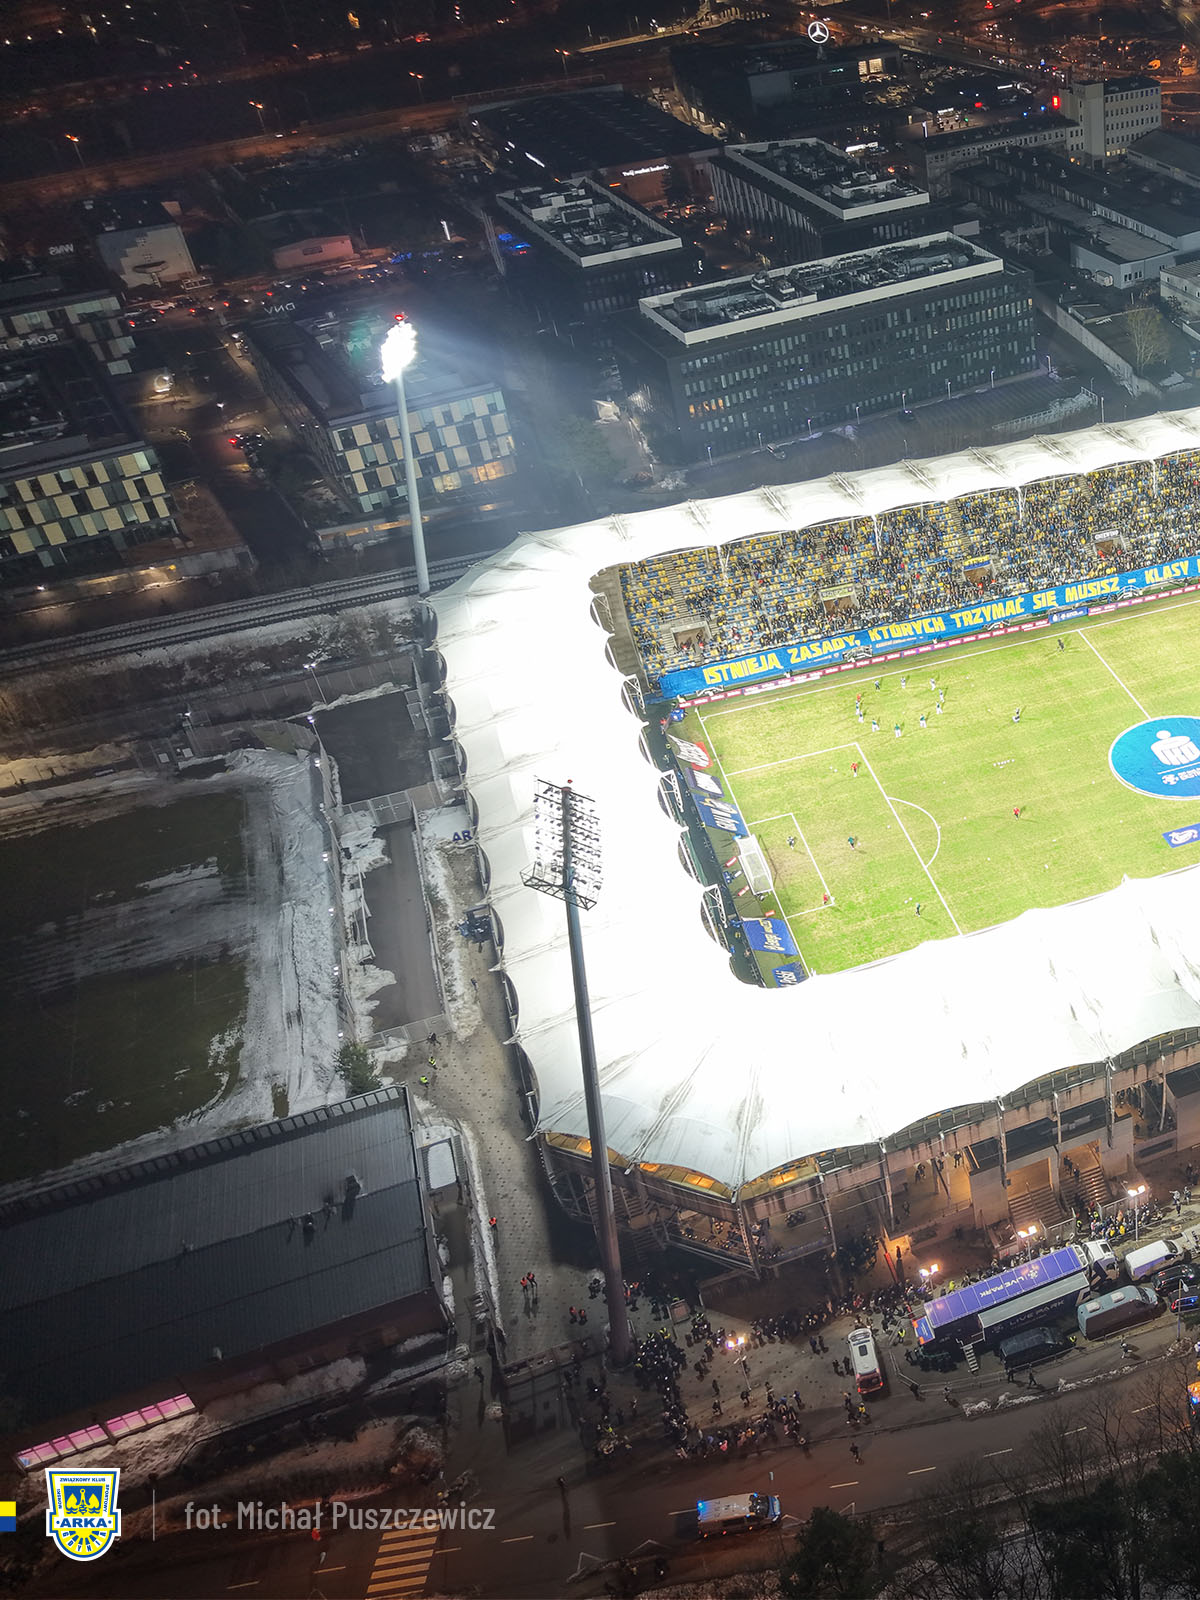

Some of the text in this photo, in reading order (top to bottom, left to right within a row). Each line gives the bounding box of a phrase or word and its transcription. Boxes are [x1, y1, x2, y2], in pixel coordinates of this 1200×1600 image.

[867, 616, 947, 642] KTÓRYCH
[950, 596, 1026, 629] TRZYMAĆ
[1032, 590, 1059, 611] SIĘ
[1065, 577, 1120, 603] MUSISZ
[1144, 560, 1190, 585] KLASY
